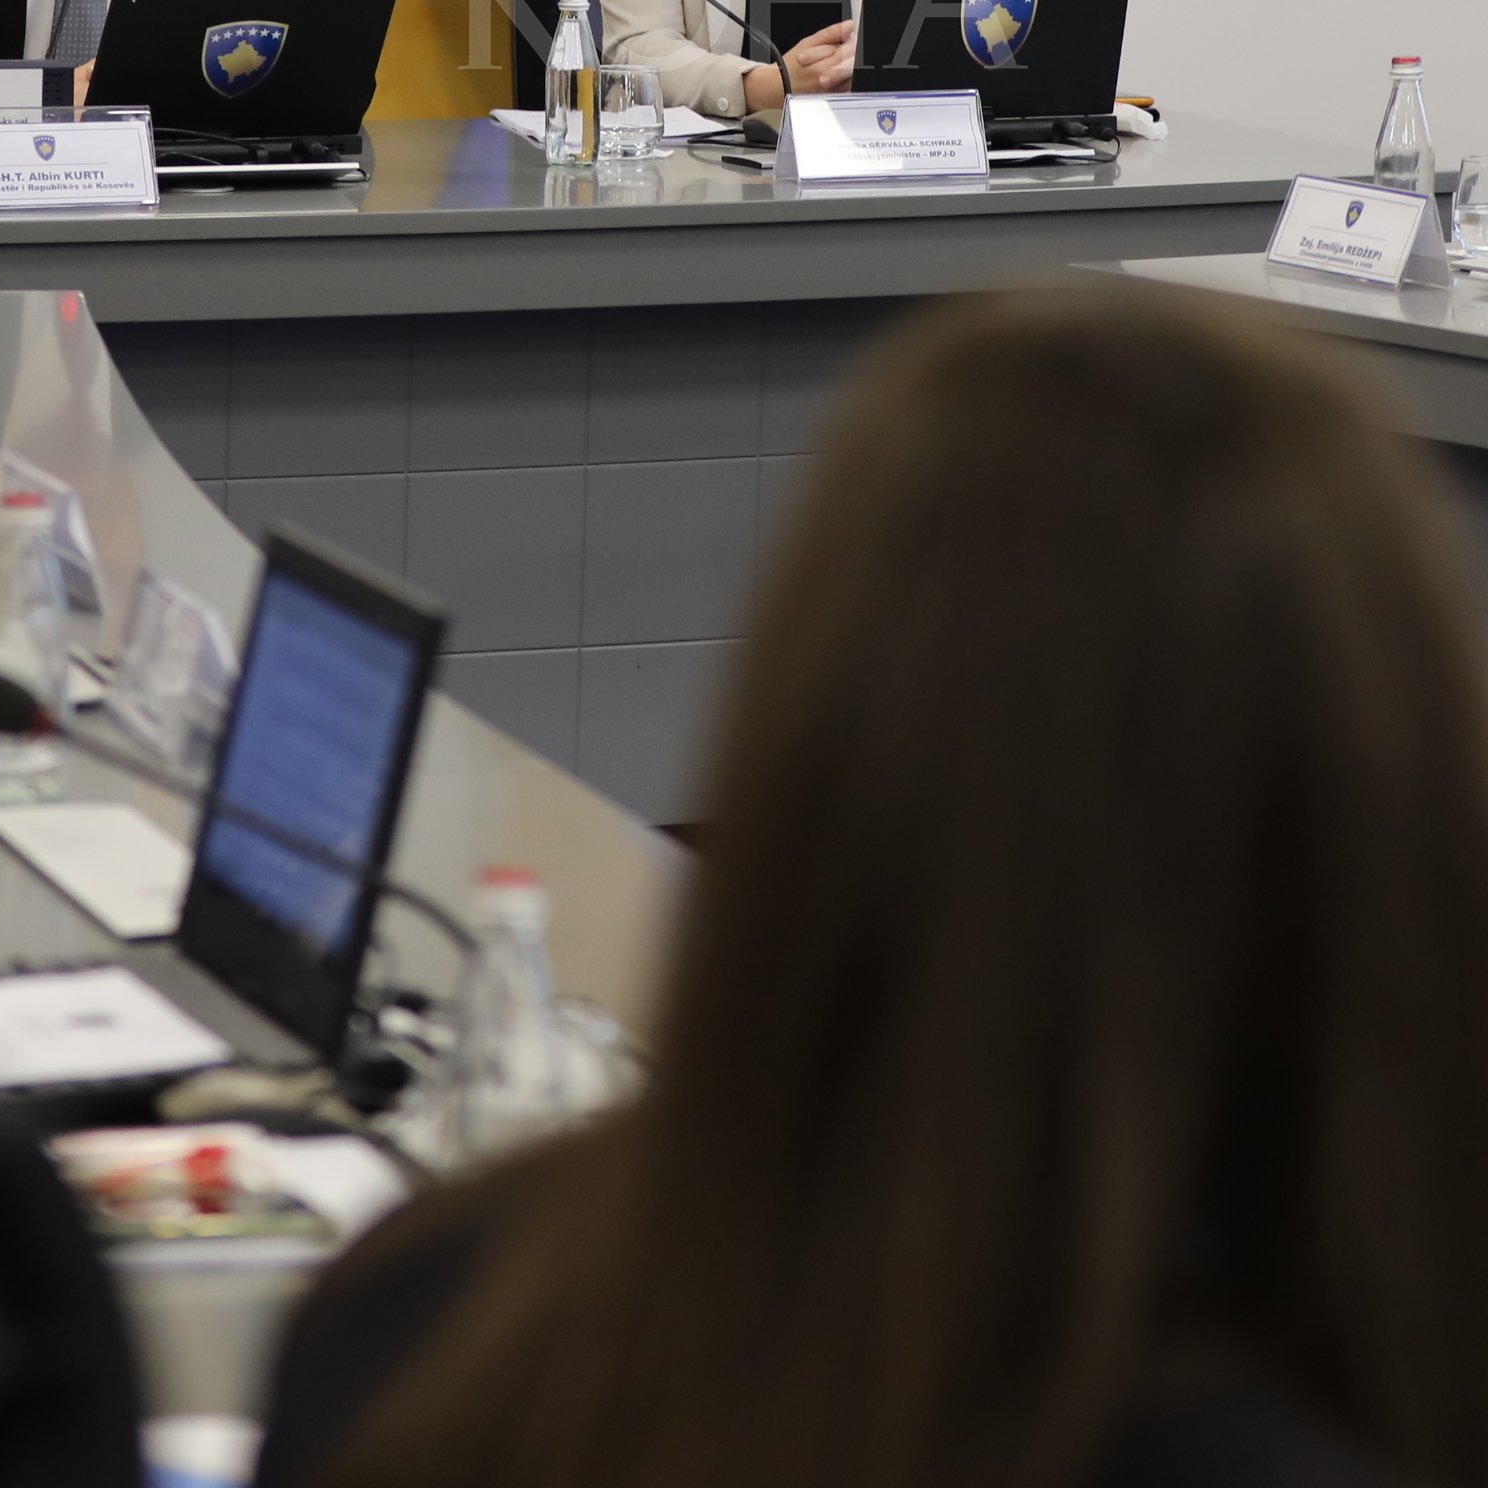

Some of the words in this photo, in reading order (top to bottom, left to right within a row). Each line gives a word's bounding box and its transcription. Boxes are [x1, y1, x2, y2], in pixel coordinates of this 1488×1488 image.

[919, 139, 963, 147] SCHWARZ
[929, 150, 956, 158] MPJ-D
[29, 171, 60, 181] Albin
[64, 170, 104, 180] KURTI
[28, 182, 79, 192] Republikës
[96, 181, 135, 189] Kosovës
